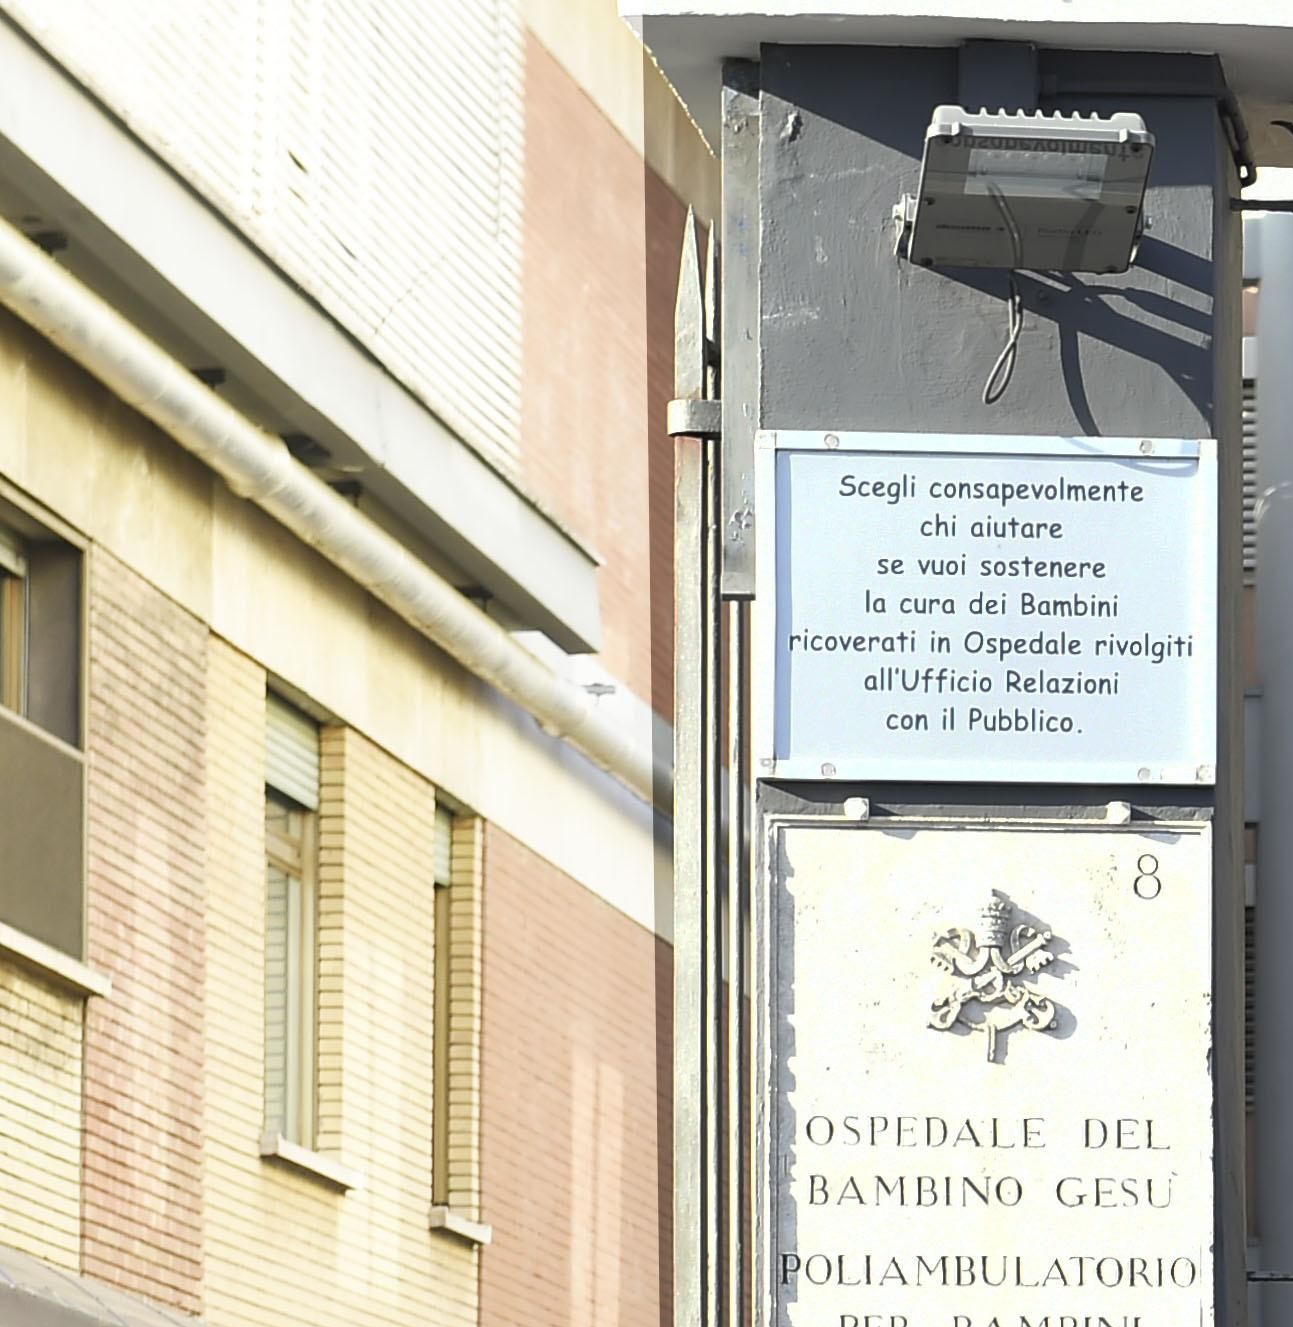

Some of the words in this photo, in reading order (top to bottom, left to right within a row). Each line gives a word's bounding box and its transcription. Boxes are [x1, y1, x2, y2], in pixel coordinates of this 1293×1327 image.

[840, 475, 915, 504] Scegli
[930, 477, 1143, 506] consapevolmente
[921, 514, 956, 536] chi
[971, 516, 1062, 538] aiutare
[878, 559, 904, 574] se
[918, 554, 965, 575] vuoi
[981, 557, 1105, 578] sostenere
[866, 590, 885, 612] la
[900, 598, 955, 613] cura
[970, 592, 1006, 614] dei
[1022, 593, 1117, 617] Bambini
[790, 629, 915, 652] ricoverati
[932, 631, 950, 652] in
[965, 631, 1081, 661] Ospedale
[1096, 633, 1192, 663] rivolgiti
[865, 668, 991, 692] all'Ufficio
[1007, 670, 1118, 694] Relazioni
[887, 714, 927, 730] con
[943, 708, 954, 730] il
[970, 708, 1081, 733] Pubblico.
[1134, 854, 1161, 899] 8
[805, 1116, 1046, 1151] OSPEDALE
[1082, 1118, 1171, 1152] DEL
[808, 1174, 1023, 1208] BAMBINO
[1055, 1171, 1179, 1211] GESÙ
[780, 1252, 1197, 1289] POLIAMBULATORIO
